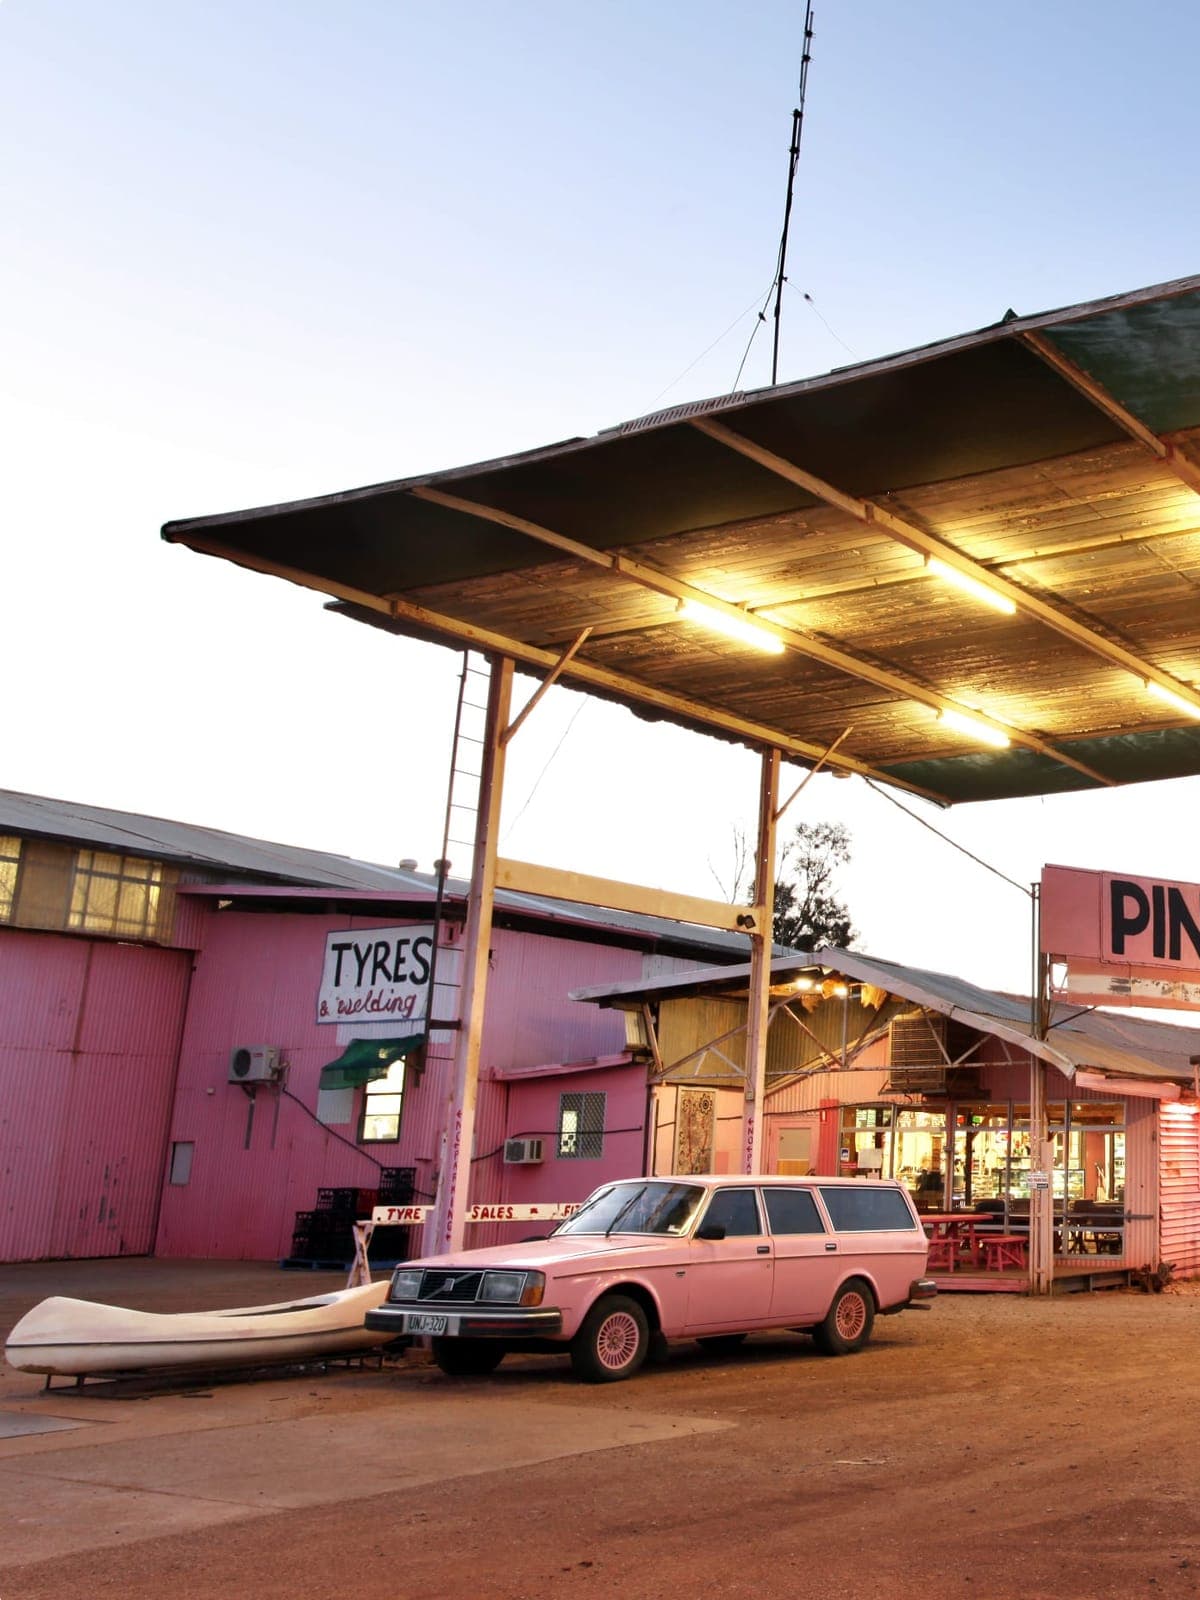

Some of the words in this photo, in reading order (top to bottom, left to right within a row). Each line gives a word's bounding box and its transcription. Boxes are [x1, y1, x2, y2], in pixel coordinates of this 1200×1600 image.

[331, 936, 433, 987] TYRES
[320, 1000, 329, 1017] &
[337, 989, 417, 1019] welding
[387, 1207, 421, 1220] TYRE
[471, 1205, 513, 1219] SALES
